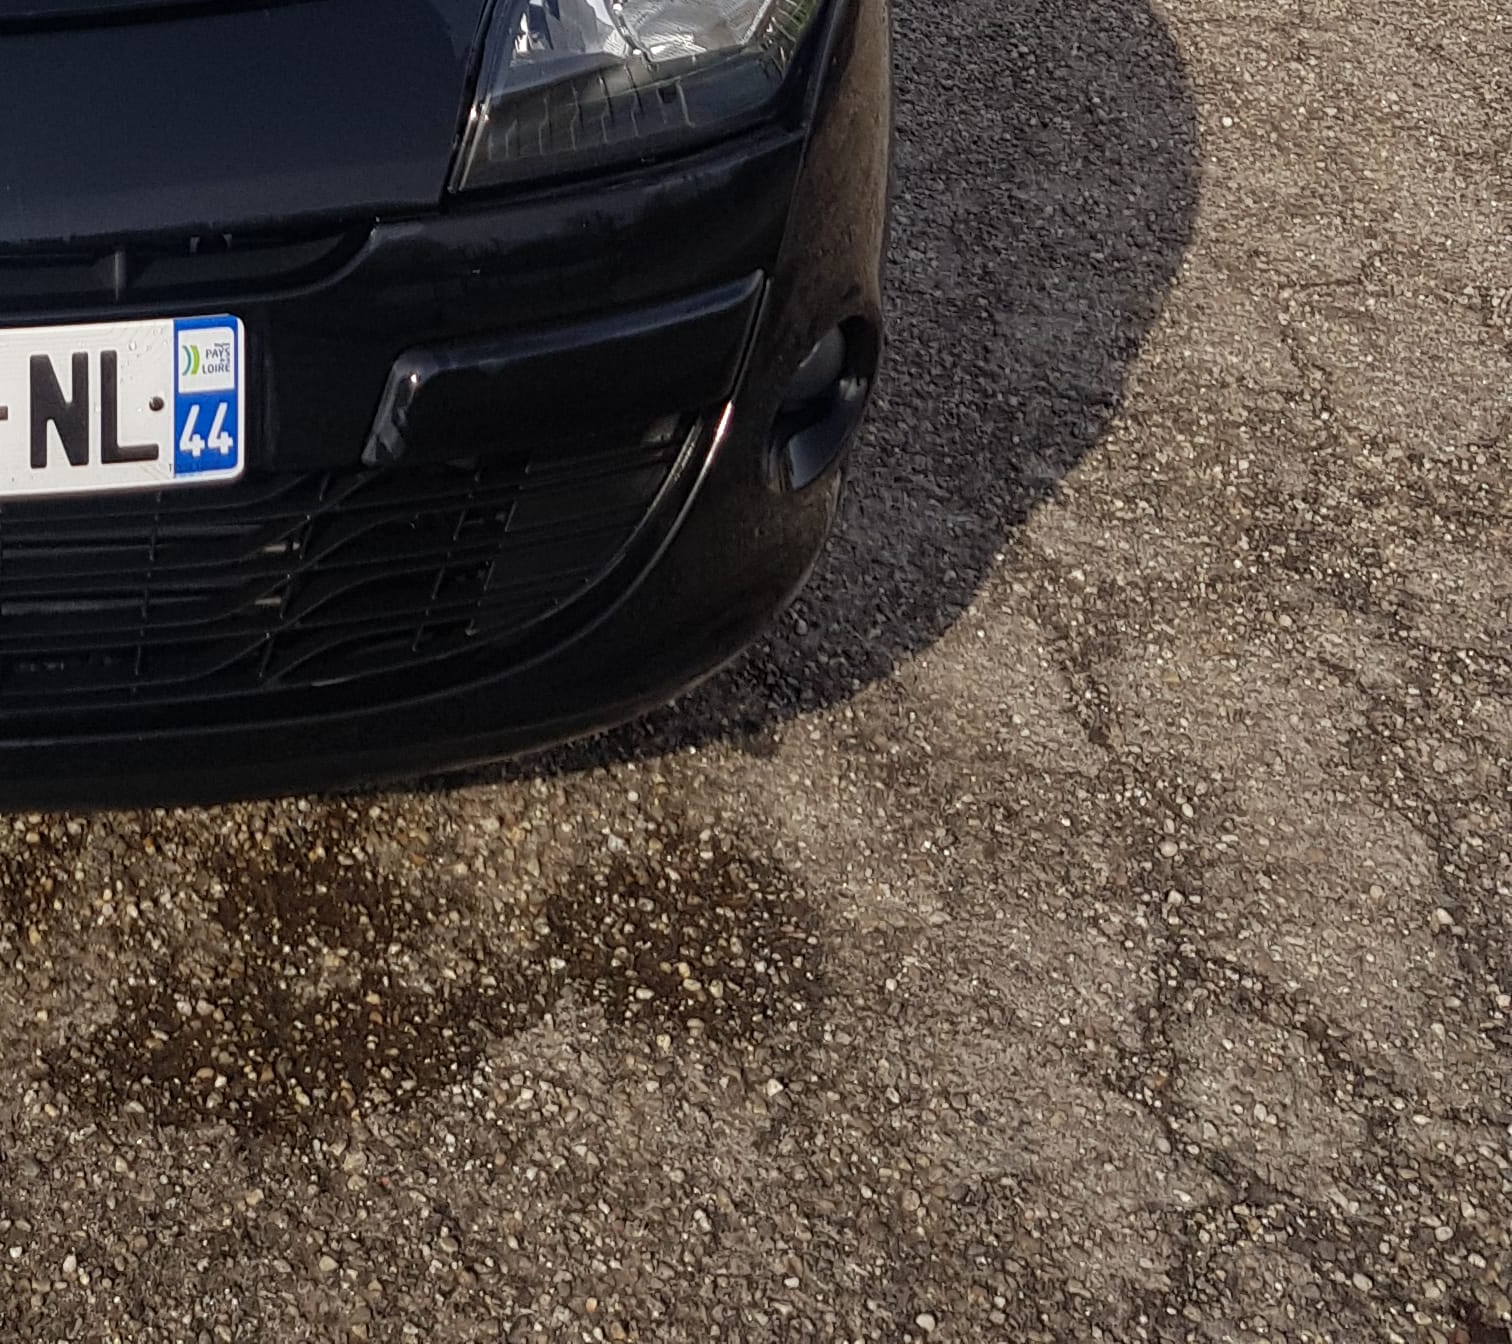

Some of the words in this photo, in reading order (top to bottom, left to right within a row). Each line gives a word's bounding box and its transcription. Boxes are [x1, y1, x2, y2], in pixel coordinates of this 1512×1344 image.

[205, 348, 231, 360] PAYS
[201, 363, 231, 375] LOIRE
[179, 402, 233, 458] 44
